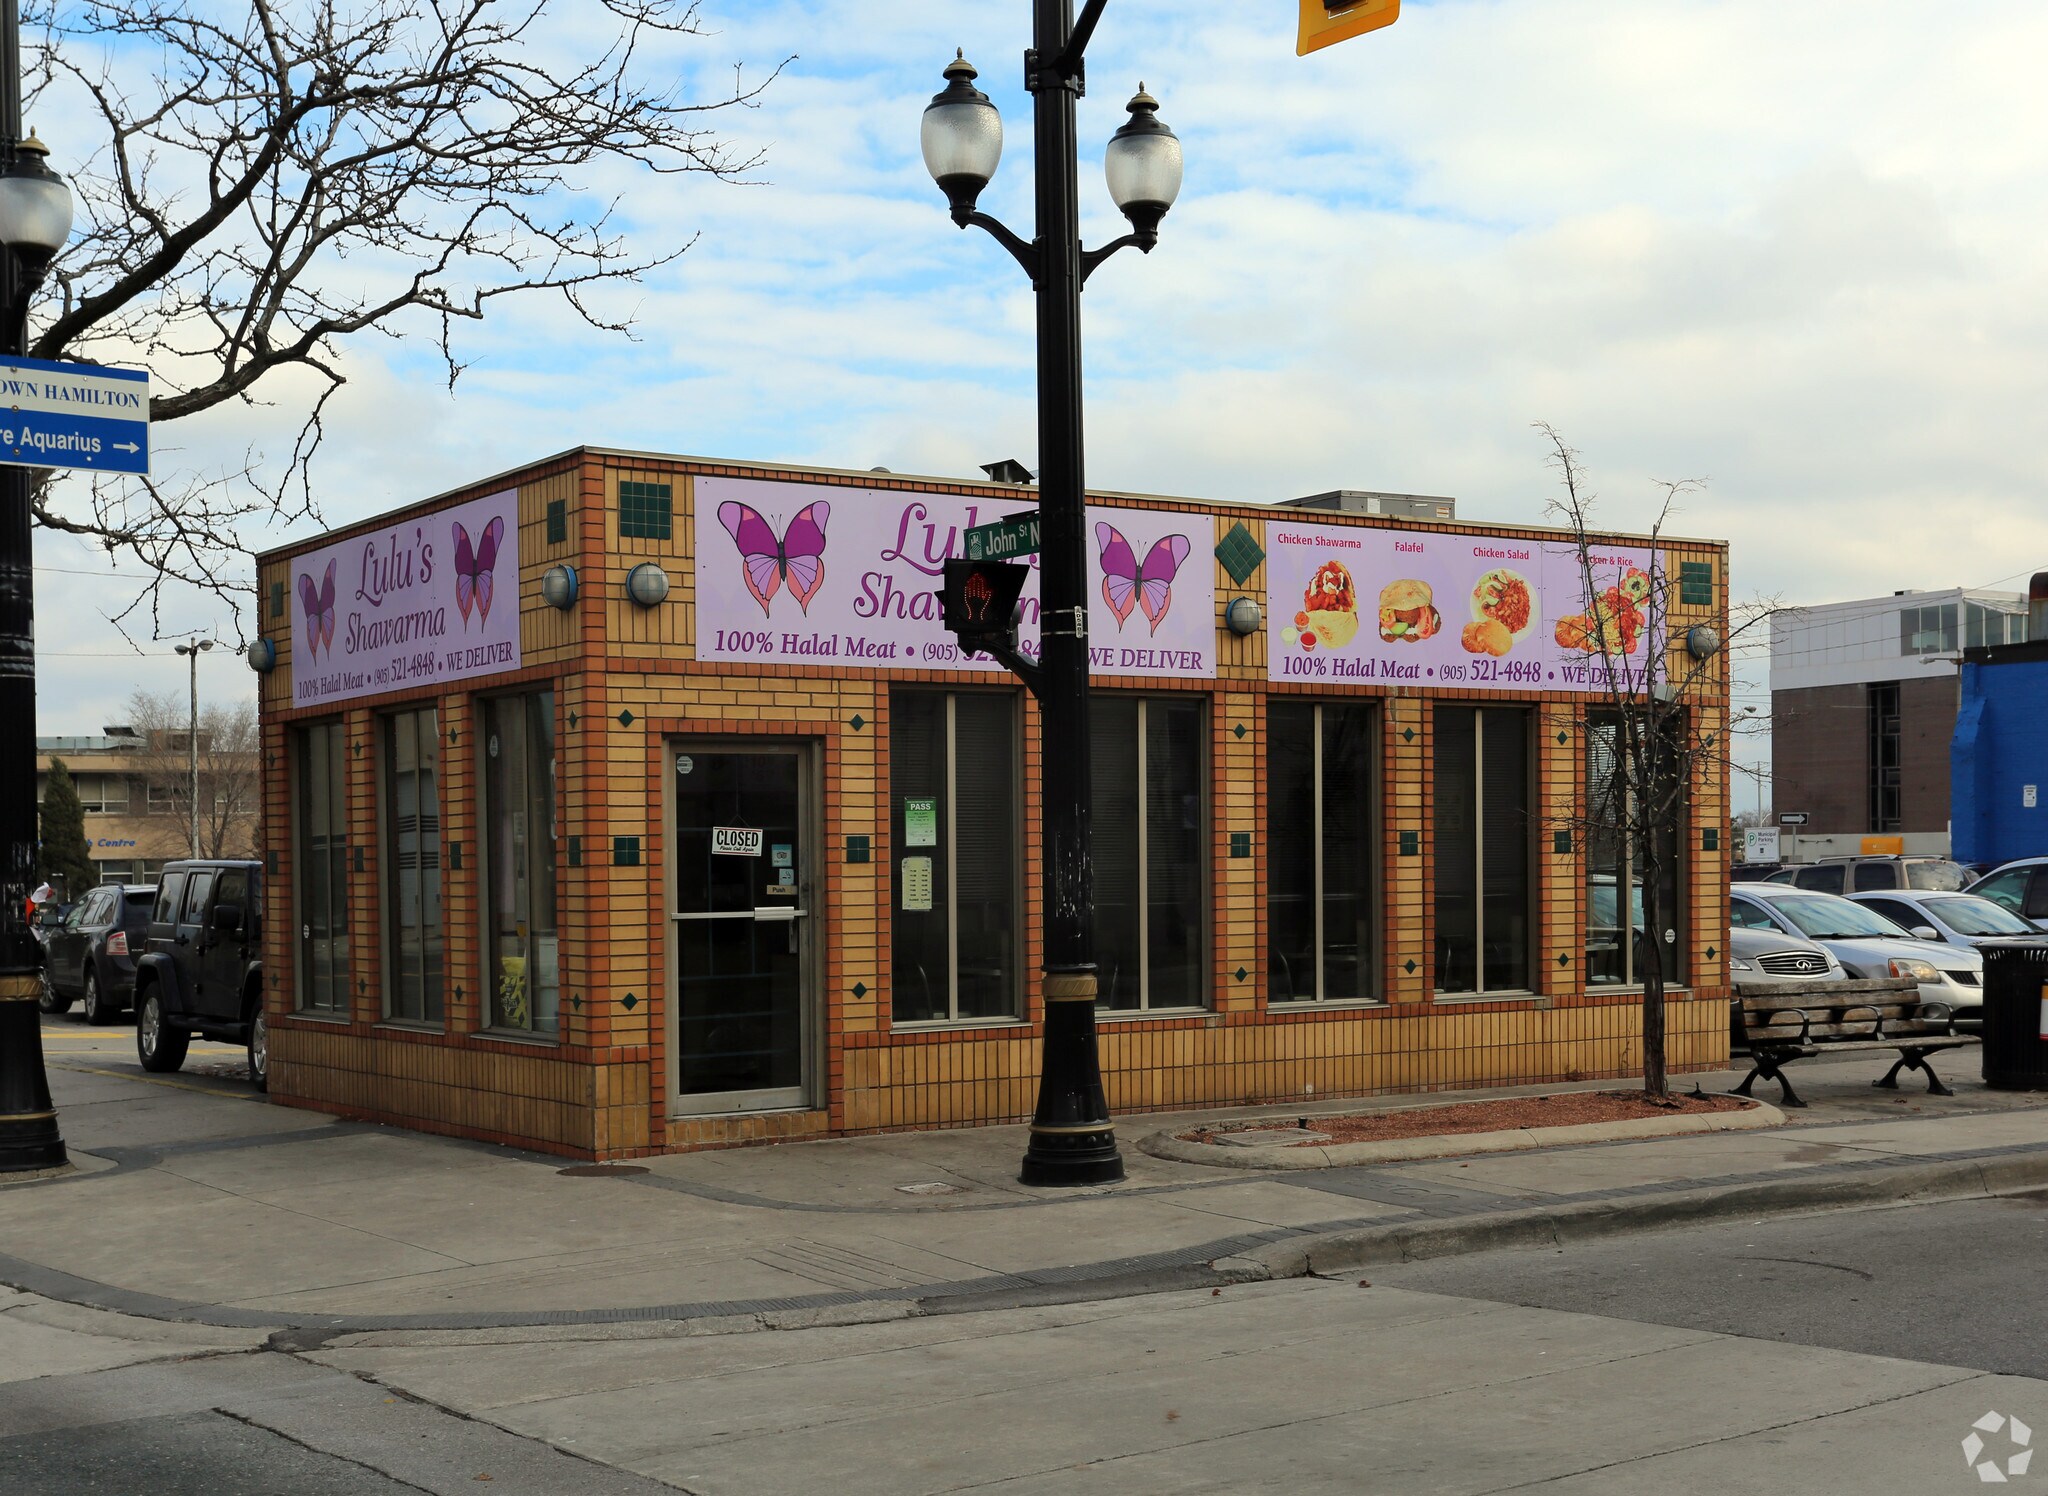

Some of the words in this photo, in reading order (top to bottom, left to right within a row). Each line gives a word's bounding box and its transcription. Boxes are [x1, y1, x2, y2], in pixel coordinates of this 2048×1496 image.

[44, 383, 140, 409] HAMILTON
[20, 426, 102, 453] Aquarius
[985, 528, 1017, 556] John
[1018, 524, 1028, 538] St
[1029, 520, 1040, 547] N
[1277, 533, 1313, 546] Chicken
[1315, 535, 1362, 549] Shawarma
[1394, 541, 1424, 553] Falafel
[1473, 547, 1505, 559] Chicken
[1507, 549, 1530, 560] Salad
[1609, 556, 1616, 566] &
[1617, 556, 1633, 567] Rice
[355, 527, 434, 608] Lulu's
[345, 607, 446, 655] Shawarma
[714, 630, 774, 654] 100%
[780, 633, 838, 657] Halal
[844, 636, 897, 659] Meat
[922, 641, 958, 663] (905)
[1088, 648, 1114, 668] WE
[1120, 648, 1203, 670] DELIVER
[299, 677, 319, 700] 100%
[320, 672, 342, 696] Halal
[343, 672, 364, 690] Meat
[373, 667, 390, 687] (905)
[390, 651, 435, 682] 521-4848
[446, 650, 463, 673] WE
[465, 641, 514, 669] DELIVER
[1282, 655, 1327, 676] 100%
[1331, 657, 1376, 678] Halal
[1380, 659, 1421, 679] Meat
[1439, 663, 1467, 683] (905)
[1469, 659, 1542, 683] 521-4848
[1561, 665, 1587, 684] WE
[1590, 666, 1657, 687] DELIVE
[910, 803, 931, 811] PASS
[98, 838, 135, 847] Centre
[716, 830, 759, 847] CLOSED
